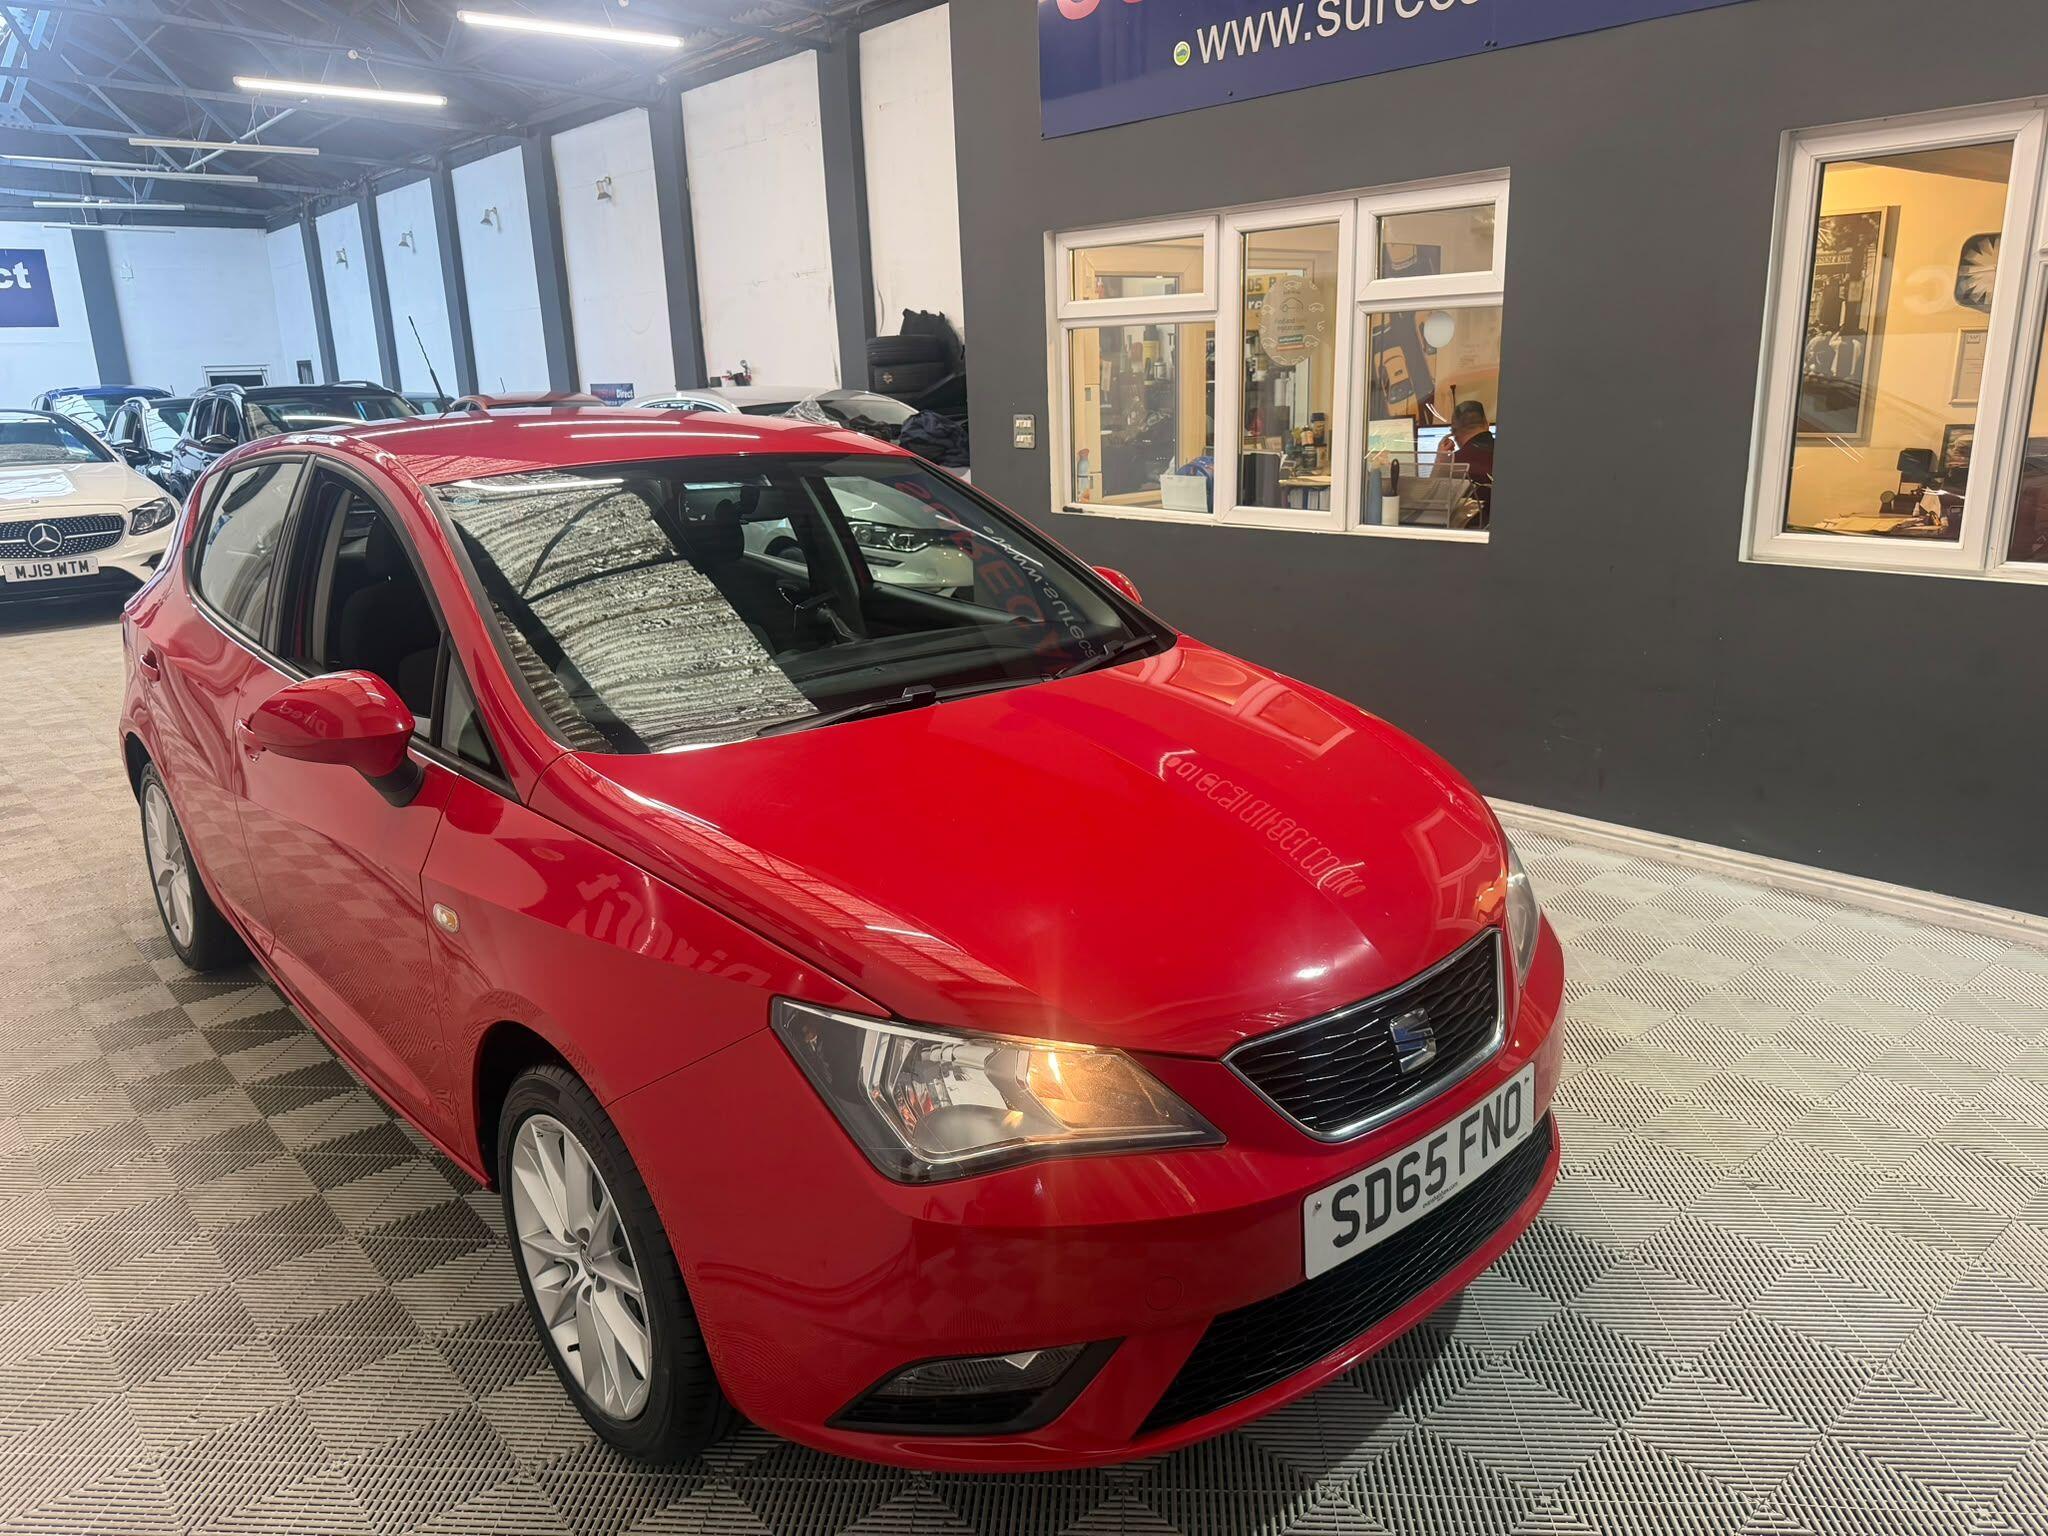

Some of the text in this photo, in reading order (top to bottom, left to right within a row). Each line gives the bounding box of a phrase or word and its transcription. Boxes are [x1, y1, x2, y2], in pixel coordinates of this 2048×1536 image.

[14, 559, 89, 579] MJ19 WTM
[1331, 1081, 1521, 1248] SD65 FNO
